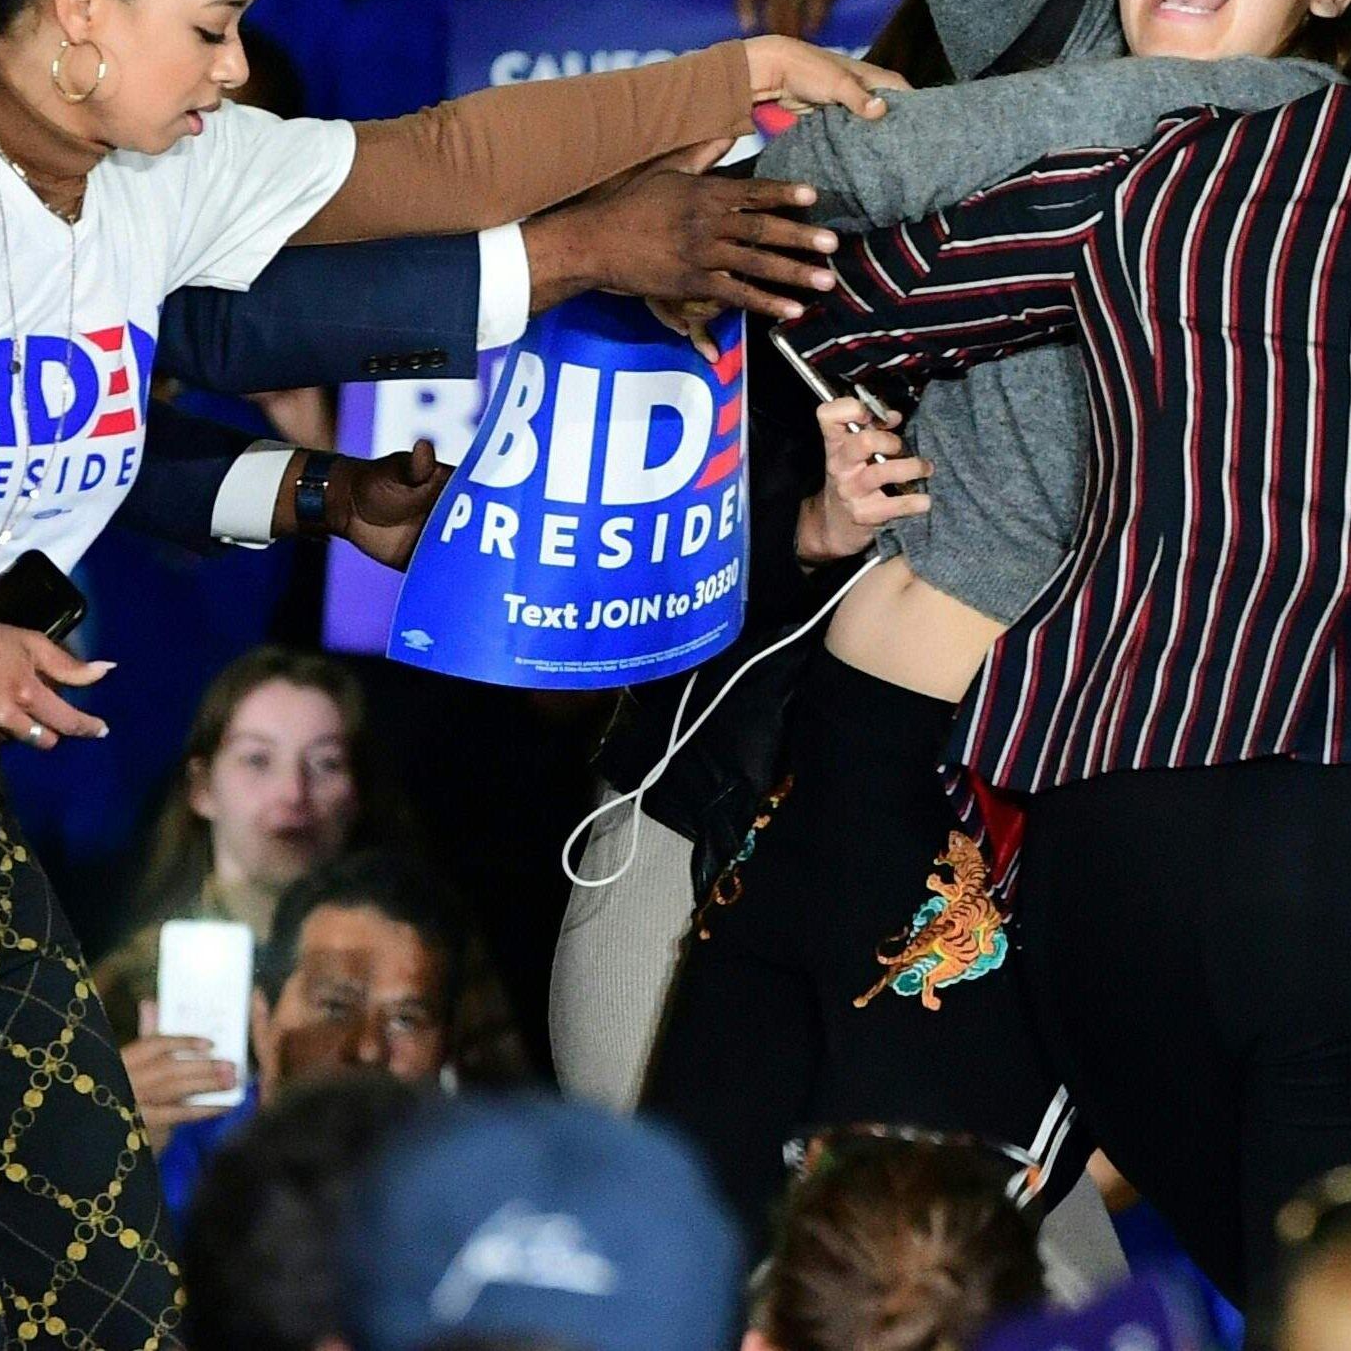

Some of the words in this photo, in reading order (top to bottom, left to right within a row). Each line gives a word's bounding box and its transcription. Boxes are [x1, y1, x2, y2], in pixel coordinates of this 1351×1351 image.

[468, 343, 746, 506] BIDE
[440, 484, 742, 569] PRESIDE
[503, 592, 579, 629] Text
[585, 593, 661, 630] JOIN
[665, 593, 689, 619] to
[692, 556, 740, 611] 30330
